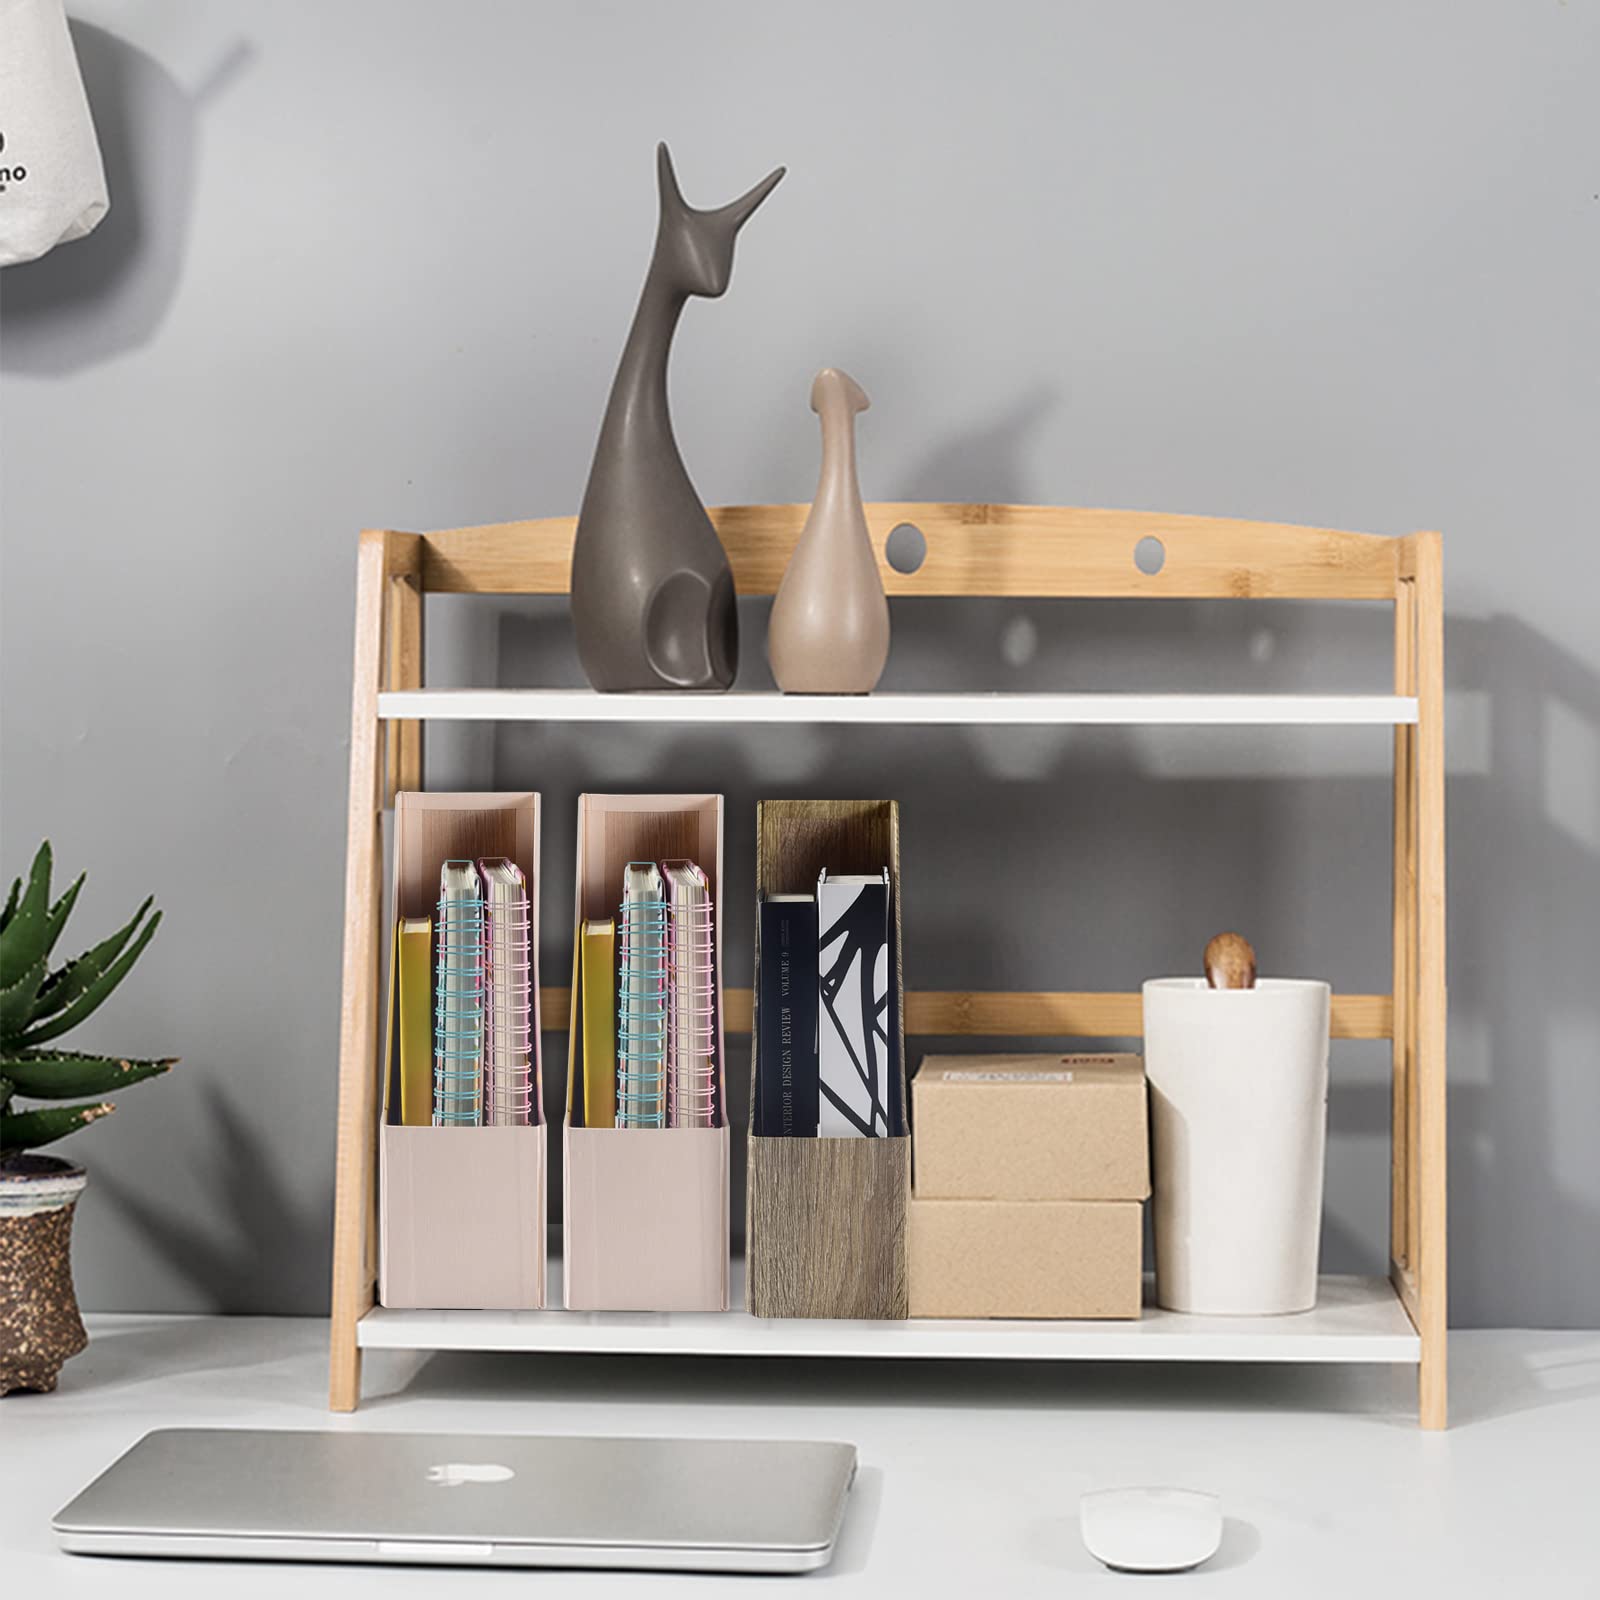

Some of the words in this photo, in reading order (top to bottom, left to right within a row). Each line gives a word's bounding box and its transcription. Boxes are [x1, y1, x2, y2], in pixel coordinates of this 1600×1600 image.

[781, 960, 790, 997] VOLUME
[781, 1007, 792, 1045] REVIEW
[782, 1049, 792, 1087] DESIGN
